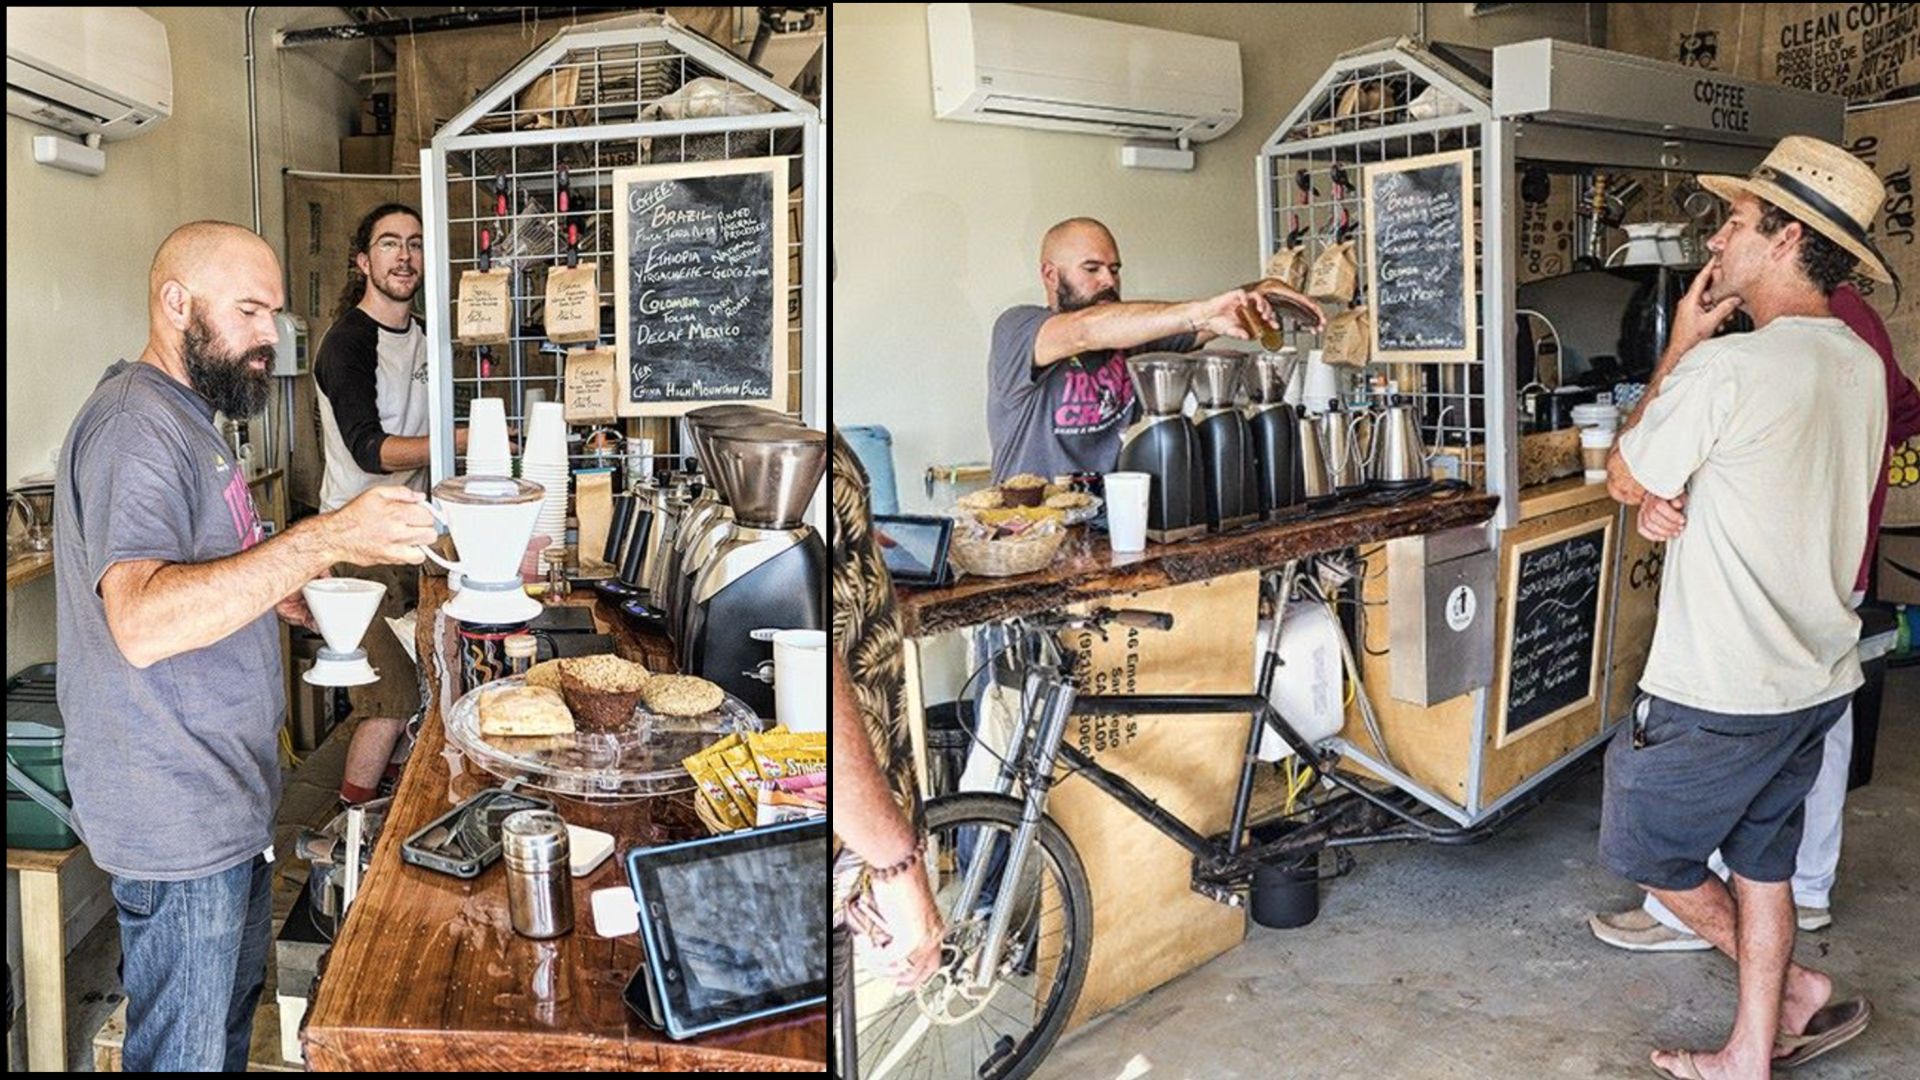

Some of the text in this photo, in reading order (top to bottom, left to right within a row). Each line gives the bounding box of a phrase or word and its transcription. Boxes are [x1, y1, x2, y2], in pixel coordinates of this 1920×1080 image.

[1781, 4, 1914, 48] CLEAN COFFE
[1841, 45, 1857, 60] DE
[1694, 80, 1745, 108] COFFEE
[1712, 107, 1749, 132] CYCLE
[652, 204, 713, 228] BRAZIL
[644, 243, 700, 273] ETHIOPIA
[640, 290, 700, 315] COLOMBIA
[637, 322, 740, 345] DECAF MEXICO
[1095, 671, 1107, 751] CA 2109
[1109, 713, 1121, 748] ego
[1126, 722, 1138, 744] St.
